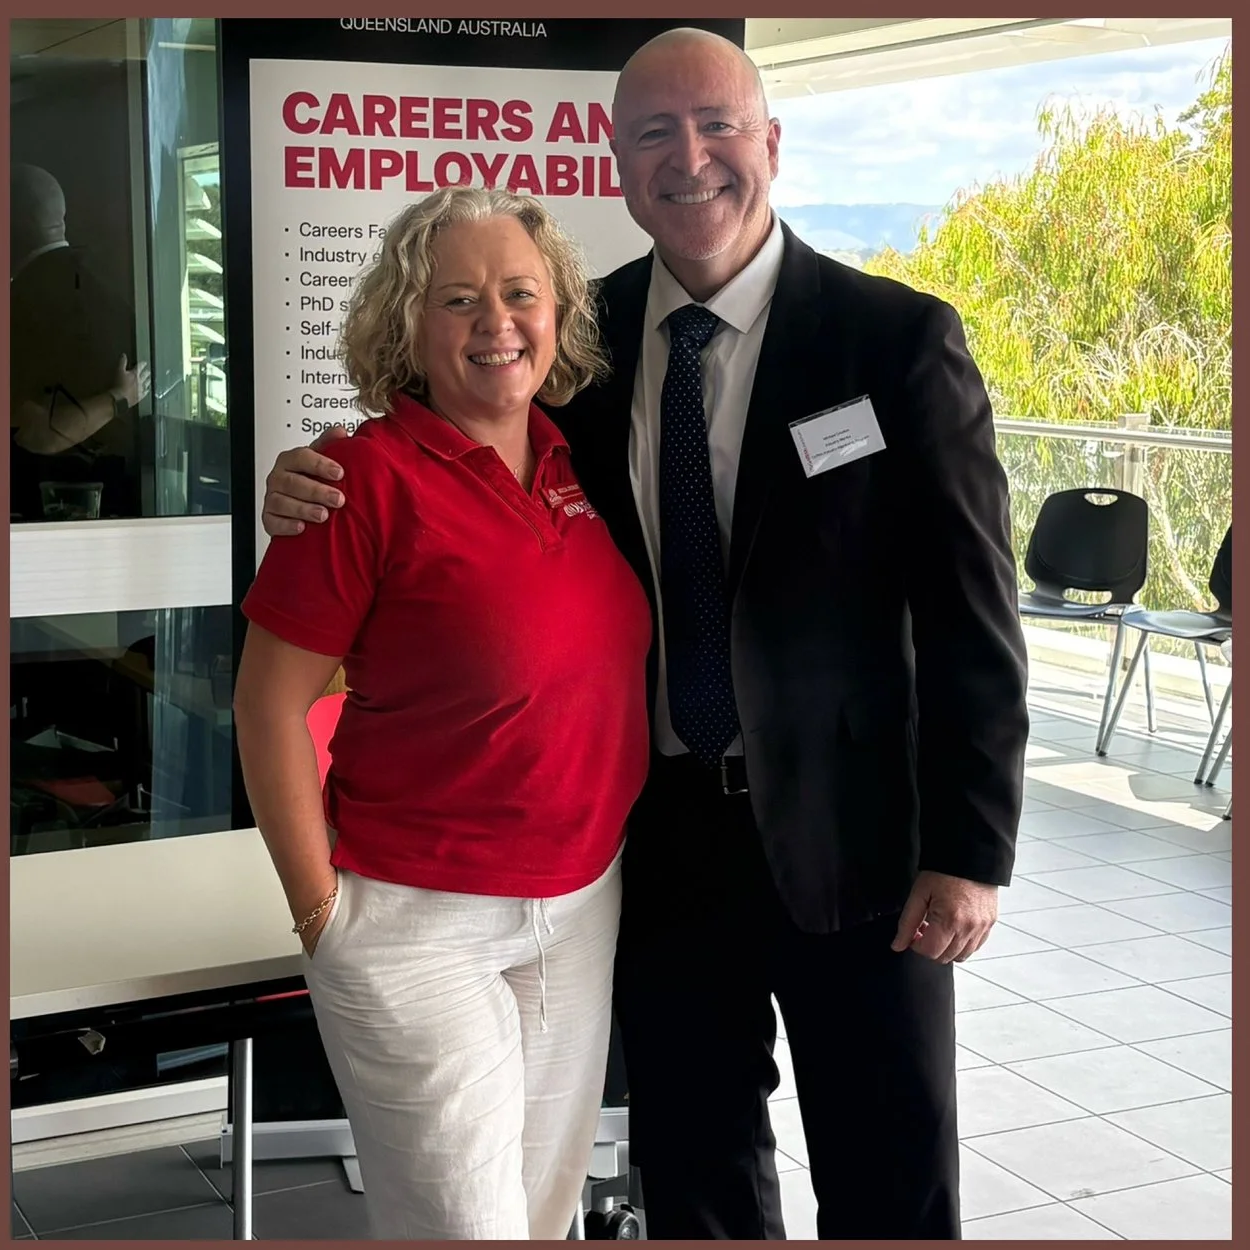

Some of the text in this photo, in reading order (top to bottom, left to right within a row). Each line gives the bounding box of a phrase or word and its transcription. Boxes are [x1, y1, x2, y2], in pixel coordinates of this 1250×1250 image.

[340, 18, 548, 38] QUEENSLAND AUSTRALIA
[282, 90, 533, 142] CAREERS
[299, 222, 363, 239] Careers
[300, 247, 367, 267] Industry
[300, 271, 354, 287] Career
[300, 296, 334, 312] PhD
